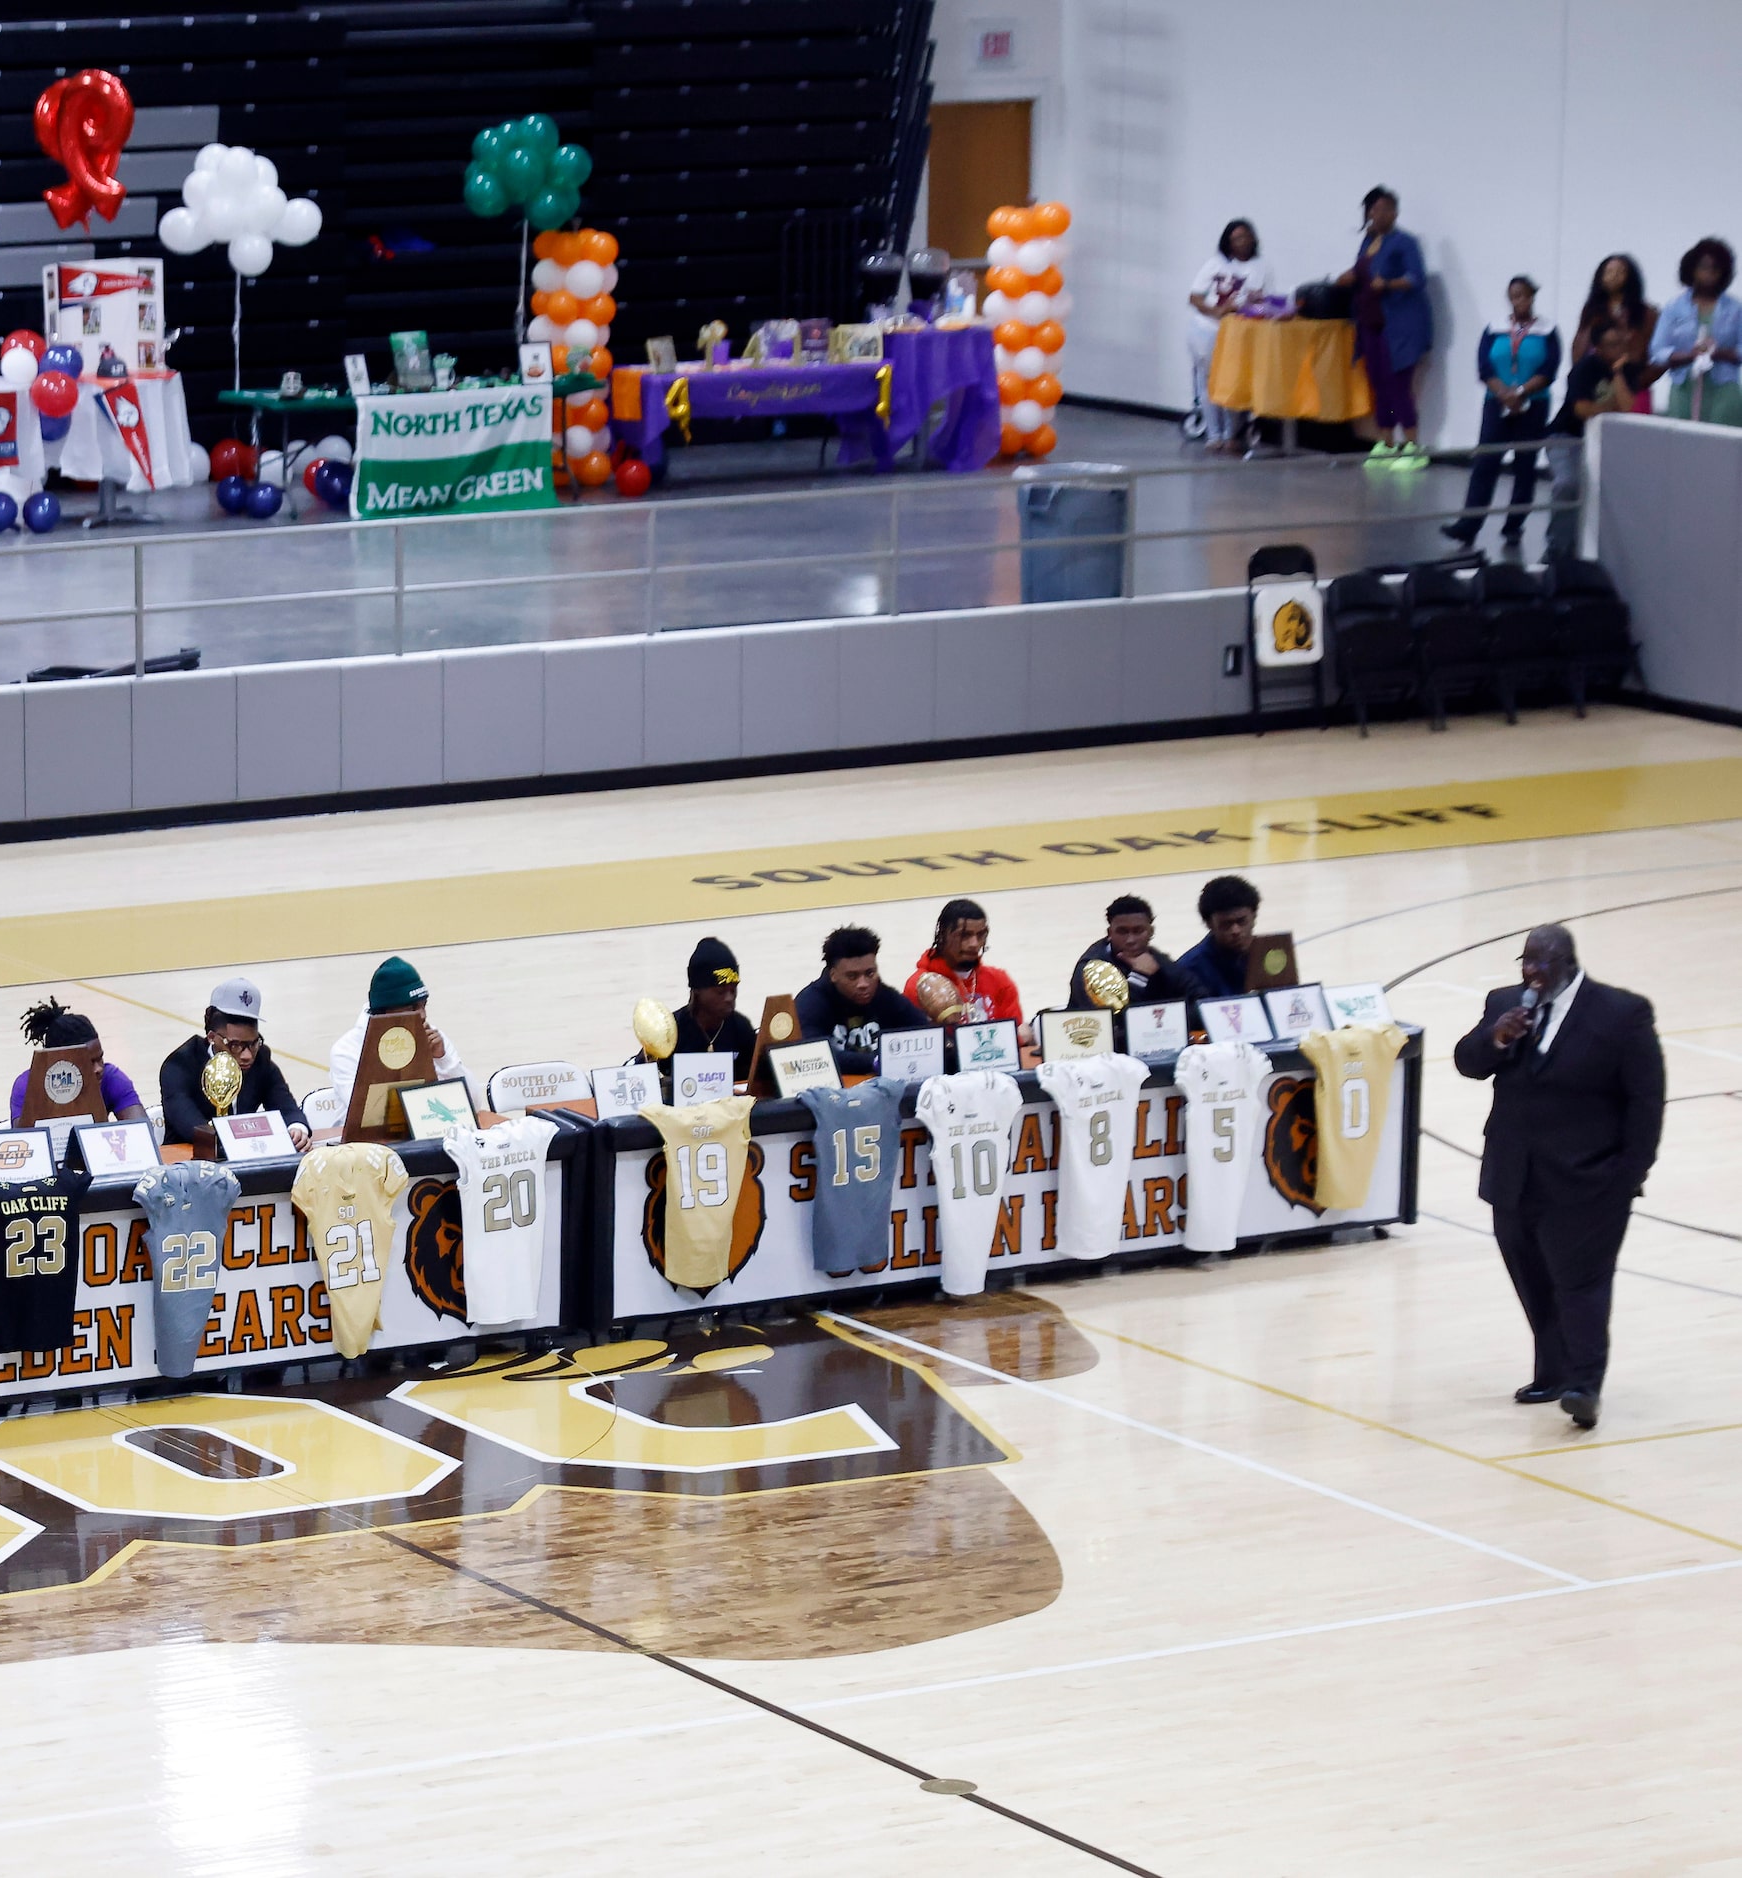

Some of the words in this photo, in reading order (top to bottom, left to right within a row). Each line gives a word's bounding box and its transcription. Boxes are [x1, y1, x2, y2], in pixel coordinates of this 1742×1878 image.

[371, 410, 461, 436] NORTH
[466, 395, 544, 430] TEXAS
[365, 482, 453, 511] MEAN
[455, 467, 544, 501] GREEN
[693, 850, 1029, 891] SOUTH
[1043, 827, 1250, 857] OAK
[1264, 803, 1508, 834] CLIFF
[904, 1037, 935, 1051] TLU
[501, 1076, 543, 1089] SOUTH
[548, 1072, 577, 1083] OAK
[522, 1085, 558, 1098] CLIFF
[1341, 1077, 1369, 1140] 0
[480, 1155, 501, 1170] THE
[503, 1149, 537, 1166] MECCA
[832, 1124, 882, 1186] 15
[1090, 1111, 1113, 1166] 8
[1213, 1107, 1235, 1163] 5
[677, 1142, 729, 1210] 19
[951, 1139, 998, 1200] 10
[0, 1197, 30, 1215] OAK
[30, 1195, 68, 1212] CLIFF
[483, 1169, 537, 1233] 20
[5, 1215, 67, 1278] 23
[83, 1218, 153, 1288] OA
[222, 1203, 318, 1271] CLI
[161, 1230, 217, 1293] 22
[326, 1219, 381, 1290] 21
[196, 1280, 333, 1359] EARS
